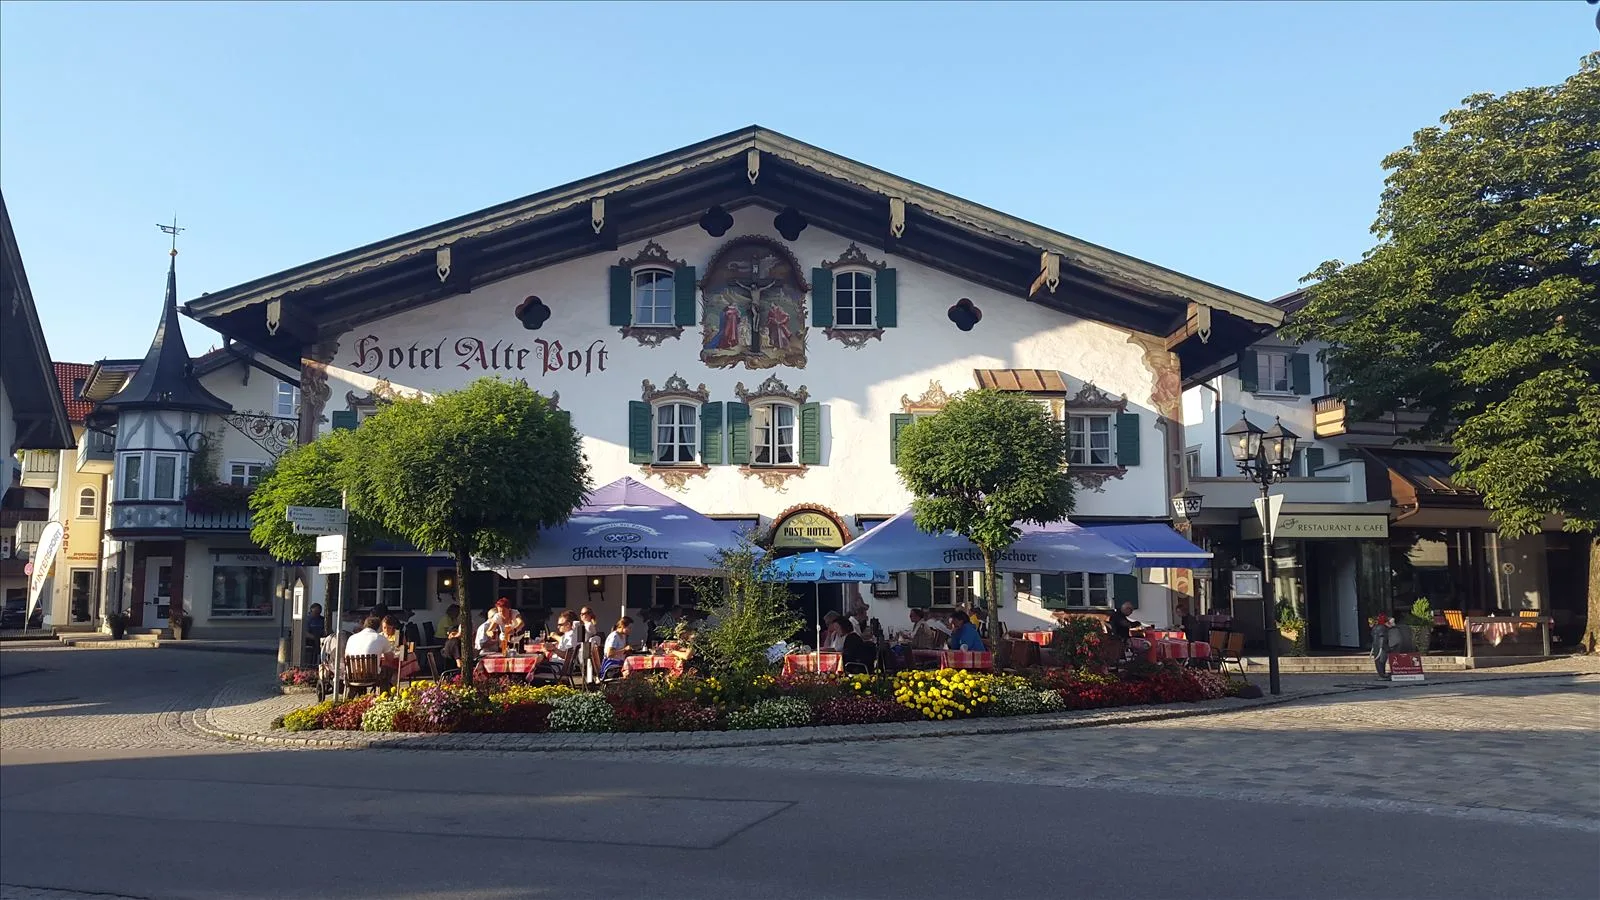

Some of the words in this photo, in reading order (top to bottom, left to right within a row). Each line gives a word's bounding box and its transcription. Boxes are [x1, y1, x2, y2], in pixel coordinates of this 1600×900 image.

[348, 334, 448, 374] Hotel
[454, 336, 530, 371] Alte
[1298, 524, 1352, 532] RESTAURANT
[37, 529, 62, 582] INTERSPORT
[572, 545, 669, 562] Hacker-Pschorr
